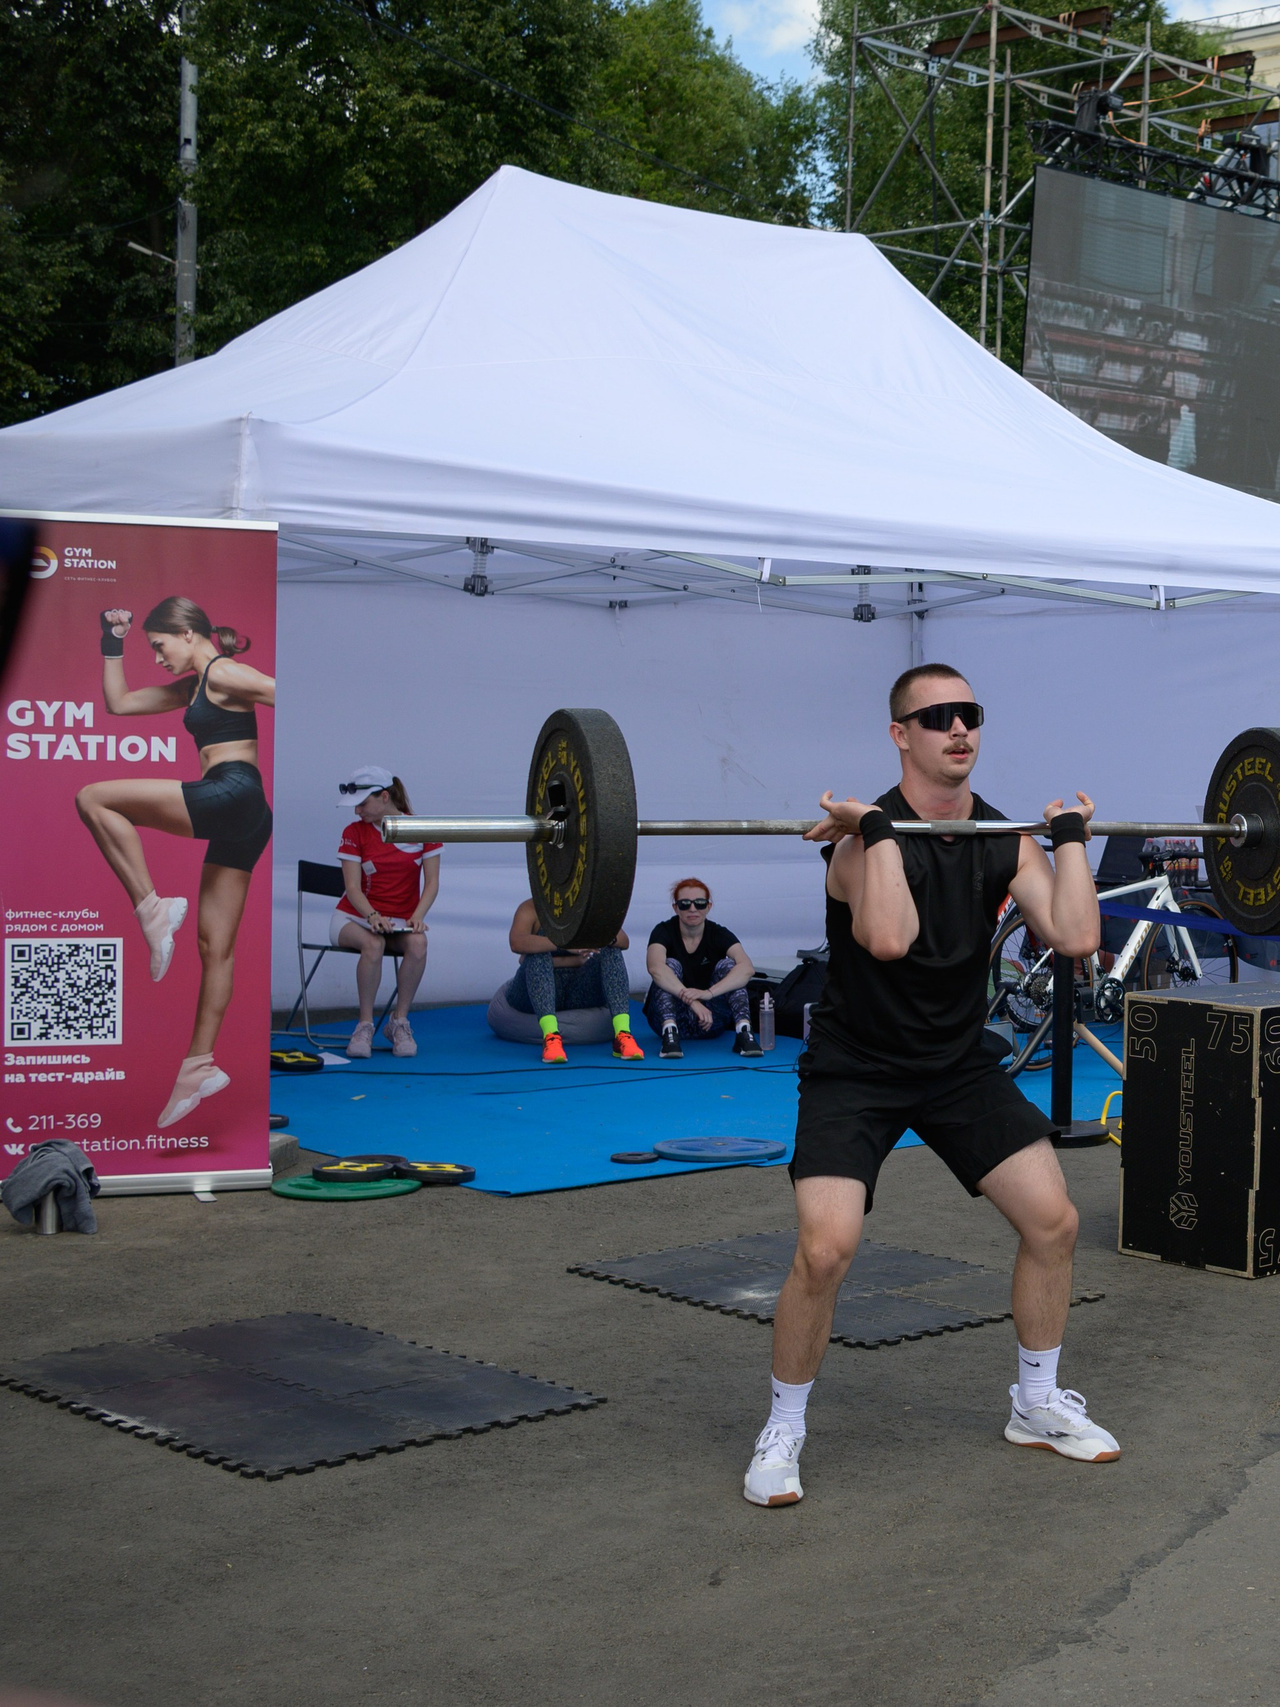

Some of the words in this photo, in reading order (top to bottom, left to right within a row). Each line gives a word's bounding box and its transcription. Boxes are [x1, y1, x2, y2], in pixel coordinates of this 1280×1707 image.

[64, 547, 92, 557] GYM
[64, 558, 116, 570] STATION
[7, 700, 94, 728] GYM
[6, 732, 176, 762] STATION
[535, 752, 557, 903] YOUTEEL
[568, 752, 588, 908] YOUSTEEL
[5, 908, 100, 922] фитнес-клубы
[5, 922, 48, 934] рядом
[50, 924, 58, 932] с
[60, 922, 104, 933] домом
[1129, 1005, 1158, 1062] 50
[1206, 1012, 1250, 1054] 75
[4, 1053, 91, 1066] Запишись
[4, 1070, 26, 1084] на
[28, 1068, 126, 1084] тест-драйв
[1178, 1038, 1196, 1186] YOUSTEEL
[28, 1113, 102, 1131] 211-369
[28, 1134, 209, 1153] tation.fitness
